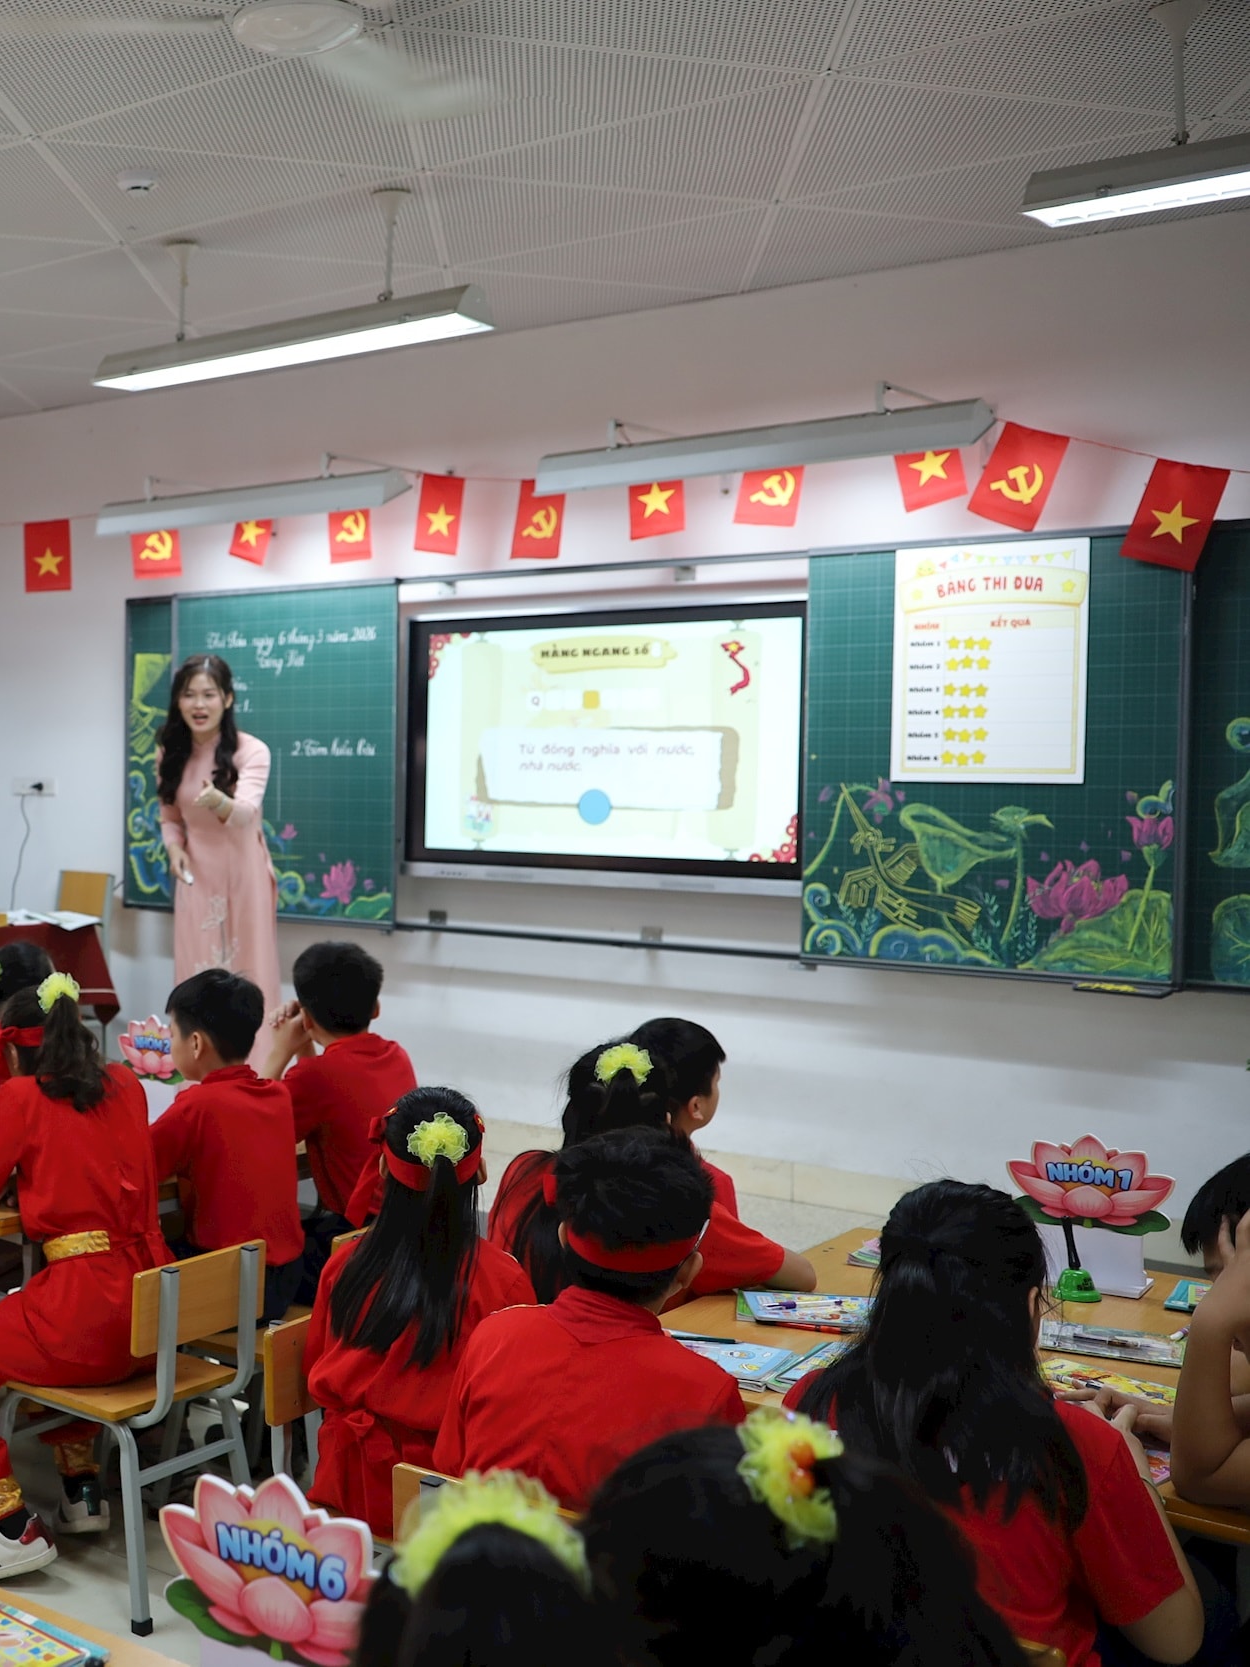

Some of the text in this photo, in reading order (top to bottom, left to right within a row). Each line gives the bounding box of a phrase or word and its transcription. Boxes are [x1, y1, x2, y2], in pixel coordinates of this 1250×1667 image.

[983, 576, 1007, 590] THI
[541, 643, 579, 658] HÀNG
[582, 647, 630, 658] NGANG
[531, 696, 540, 706] Q
[162, 1038, 171, 1054] 2
[1046, 1160, 1133, 1191] NHÓM 1
[215, 1521, 347, 1601] NHÓM 6
